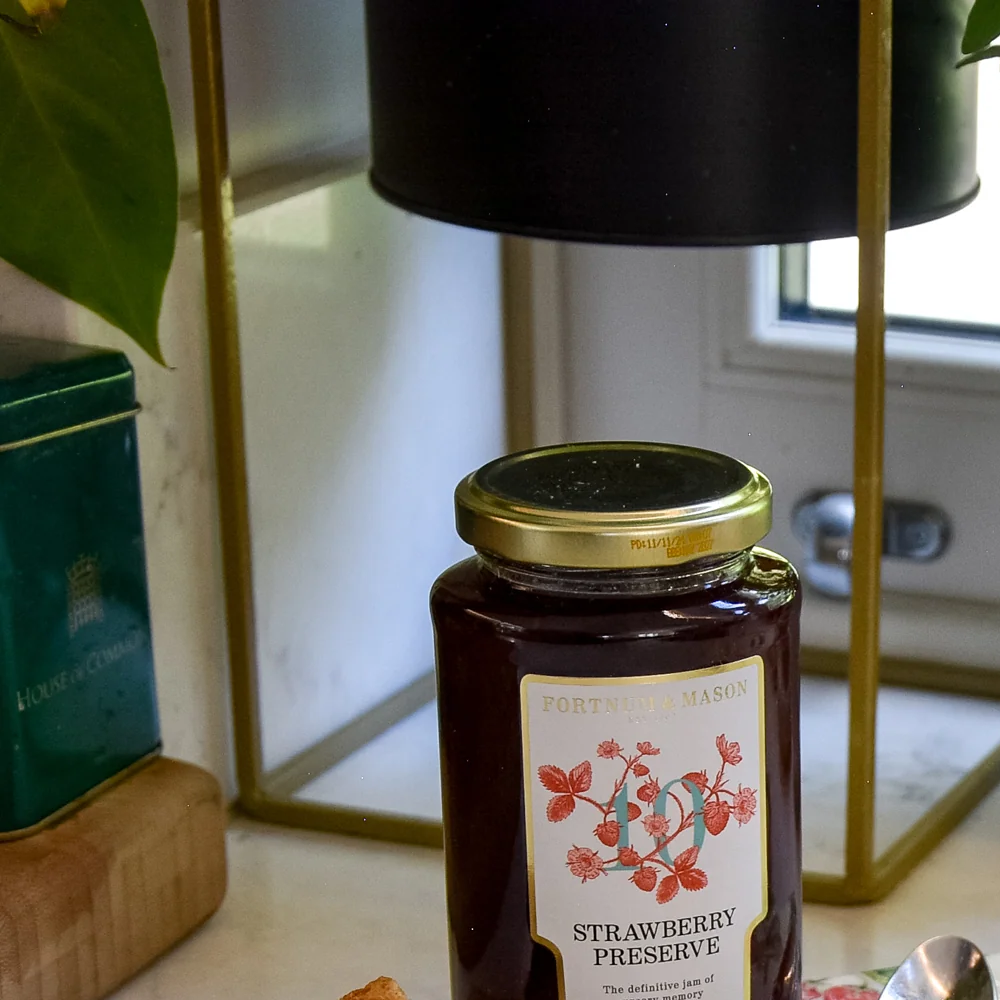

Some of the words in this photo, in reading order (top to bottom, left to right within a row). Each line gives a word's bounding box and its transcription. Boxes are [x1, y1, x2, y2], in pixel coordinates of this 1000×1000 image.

[16, 671, 70, 712] HOUSE
[86, 630, 146, 675] COMM
[541, 695, 655, 714] FORTNUM
[661, 694, 676, 711] &
[681, 679, 748, 708] MASON
[600, 779, 706, 871] 10
[573, 907, 737, 942] STRAWBERRY
[593, 936, 720, 966] PRESERVE
[602, 985, 624, 995] The
[627, 981, 680, 994] definitive
[682, 978, 702, 990] jam
[704, 974, 715, 985] of
